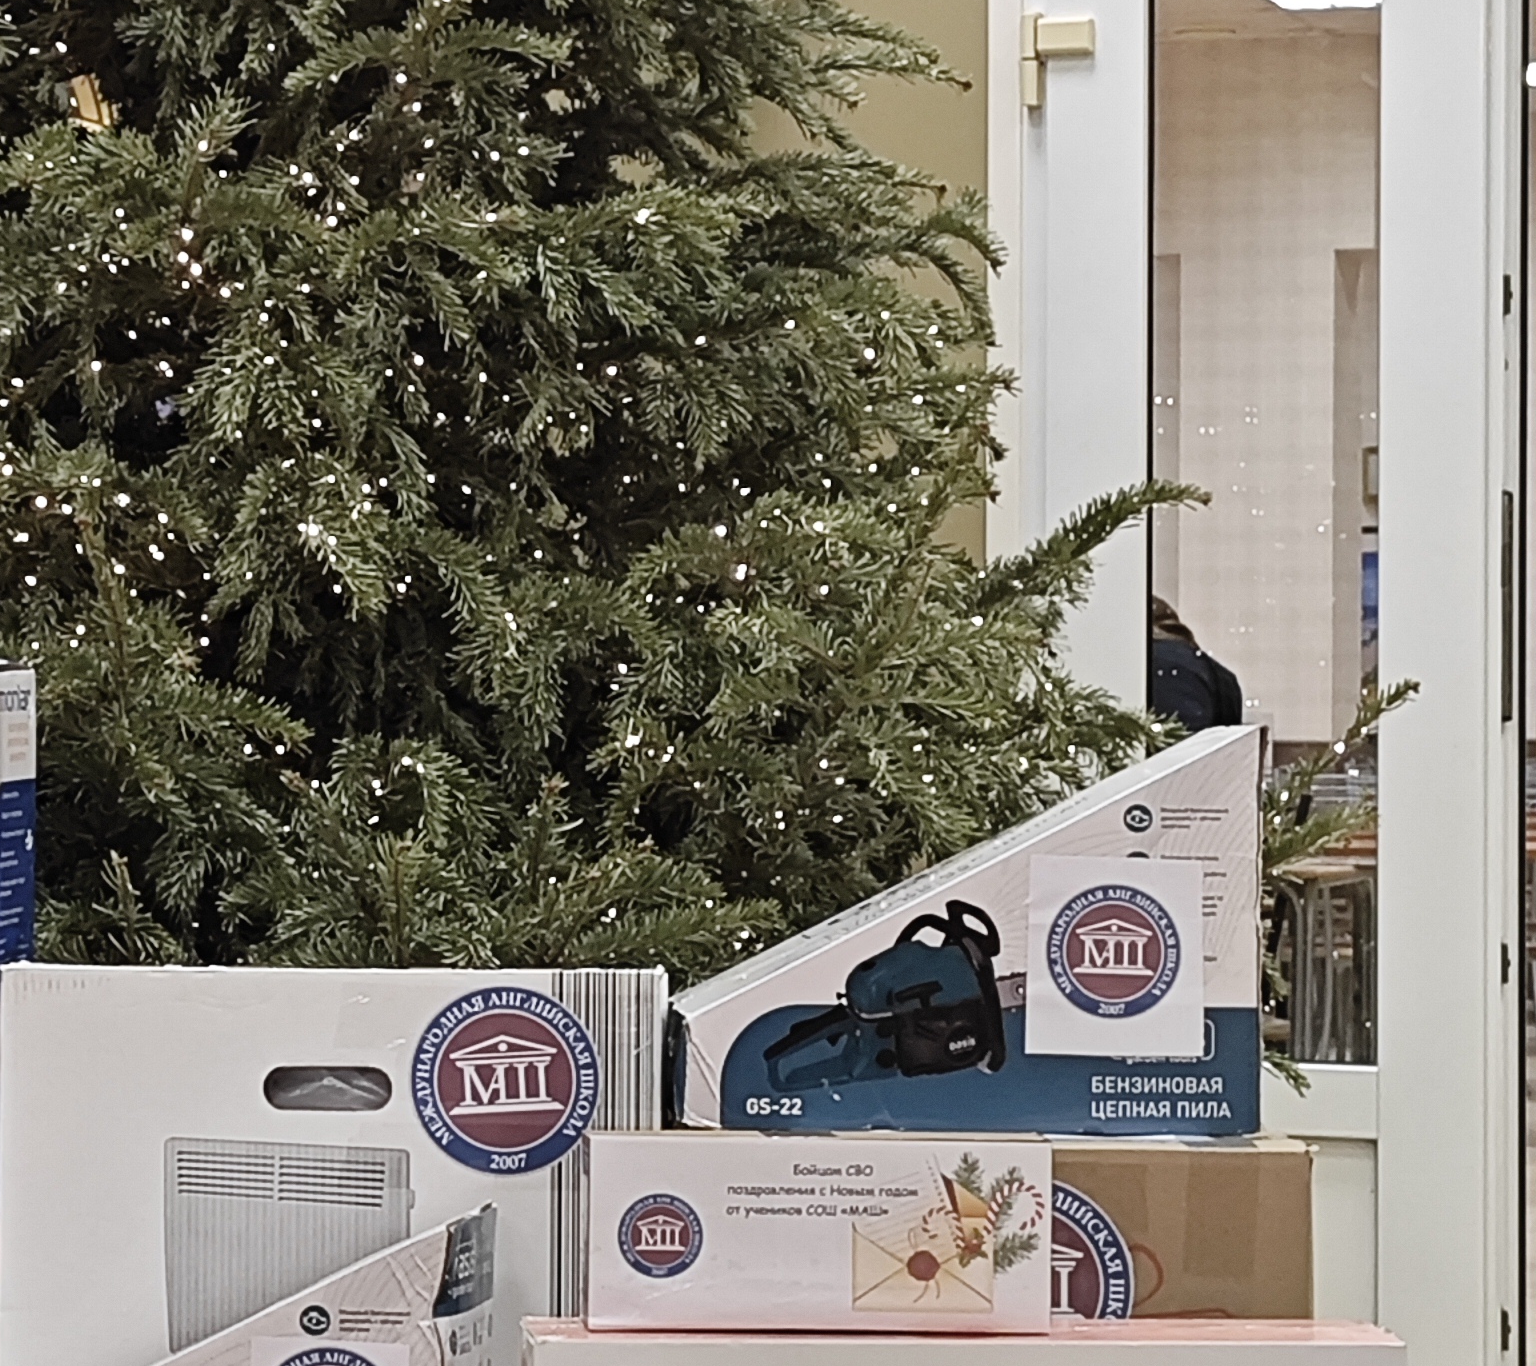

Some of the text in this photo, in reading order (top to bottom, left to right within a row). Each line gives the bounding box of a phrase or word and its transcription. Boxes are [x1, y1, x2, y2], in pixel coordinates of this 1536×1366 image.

[416, 991, 595, 1146] МЕЖДУНАРОДНАЯ АНГЛИЙСКАЯ ШКОЛА
[1091, 1076, 1223, 1094] БЕНЗИНОВАЯ
[746, 1098, 803, 1116] GS-22
[1091, 1100, 1231, 1120] ЦЕПНАЯ ПИЛА
[489, 1153, 527, 1170] 2007
[793, 1164, 873, 1177] Бойцам СВО
[830, 1185, 875, 1197] Новым
[878, 1187, 919, 1197] годом
[726, 1206, 741, 1215] от
[743, 1207, 802, 1219] учеников
[806, 1205, 837, 1217] СОШ
[1054, 1191, 1123, 1273] ЛИЙСКАЯ
